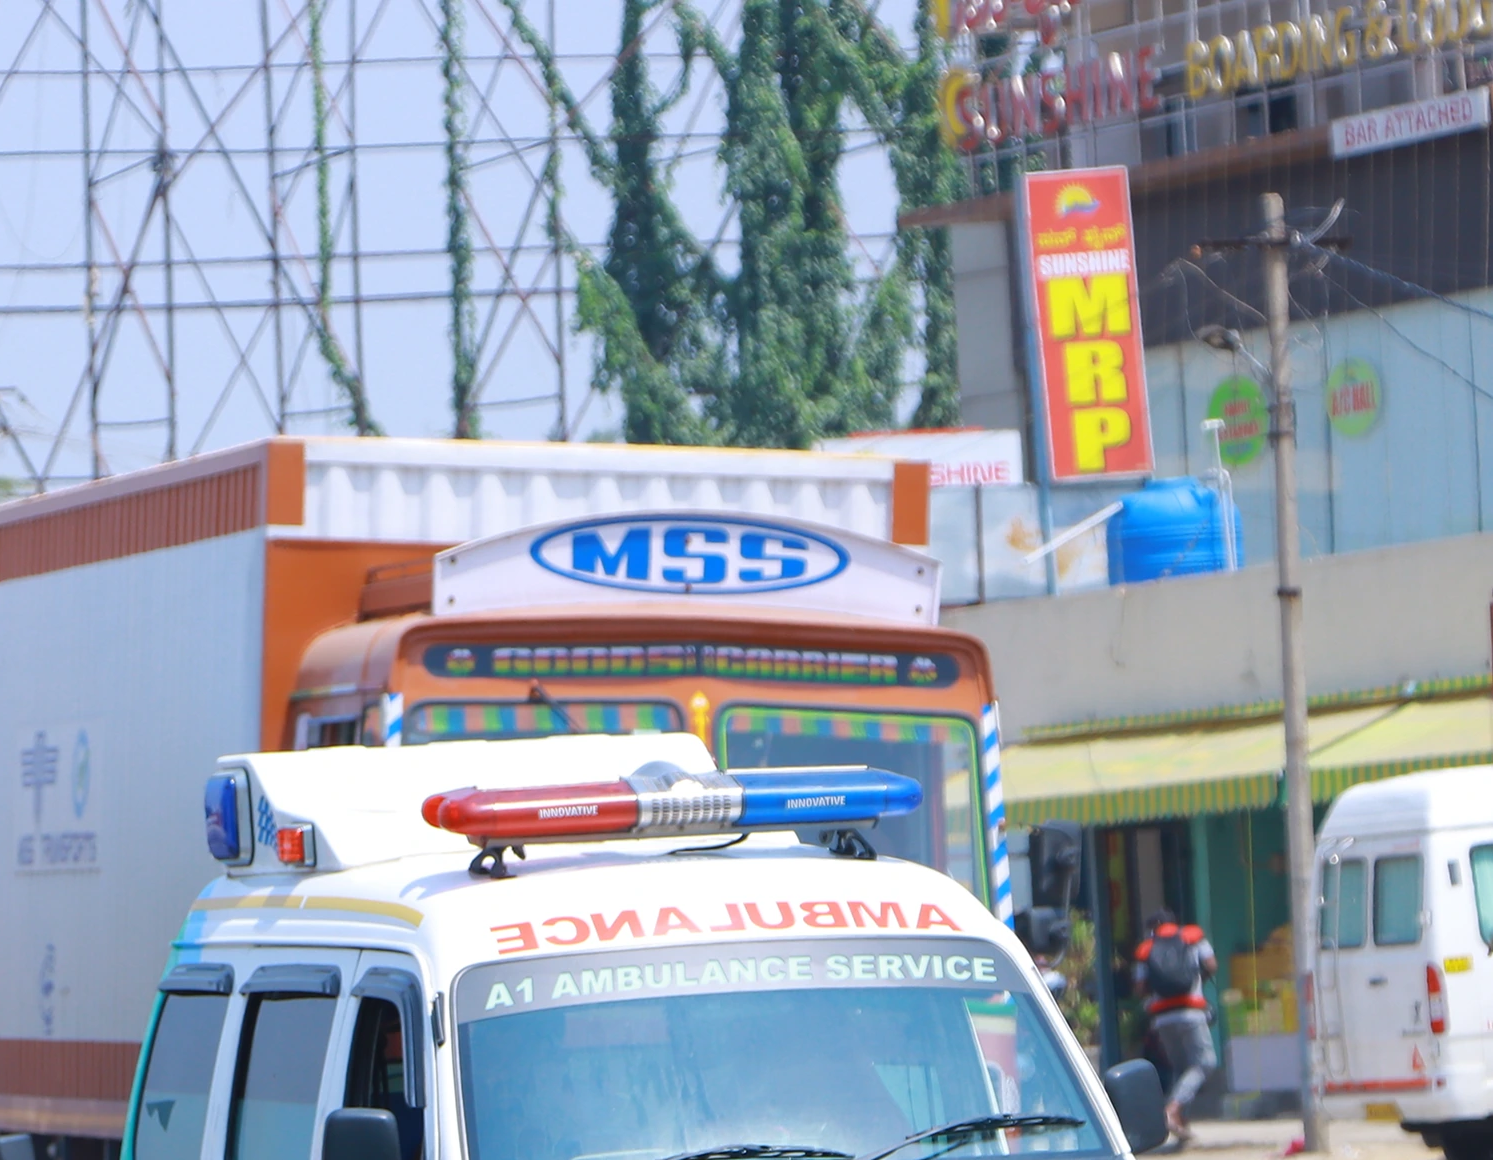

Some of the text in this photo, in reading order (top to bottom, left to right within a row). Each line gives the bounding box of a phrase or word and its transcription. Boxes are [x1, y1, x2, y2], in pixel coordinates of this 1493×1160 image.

[1187, 6, 1358, 98] BOARDING
[1344, 97, 1473, 147] BAR ATTACHED
[1039, 248, 1131, 276] SUNSHINE
[571, 525, 810, 585] MSS
[492, 645, 899, 684] GOODS CARRIER
[538, 804, 599, 820] INNOVATIVE
[787, 795, 846, 810] INNOVATIVE
[485, 953, 998, 1010] A1 AMBULANCE SERVICE
